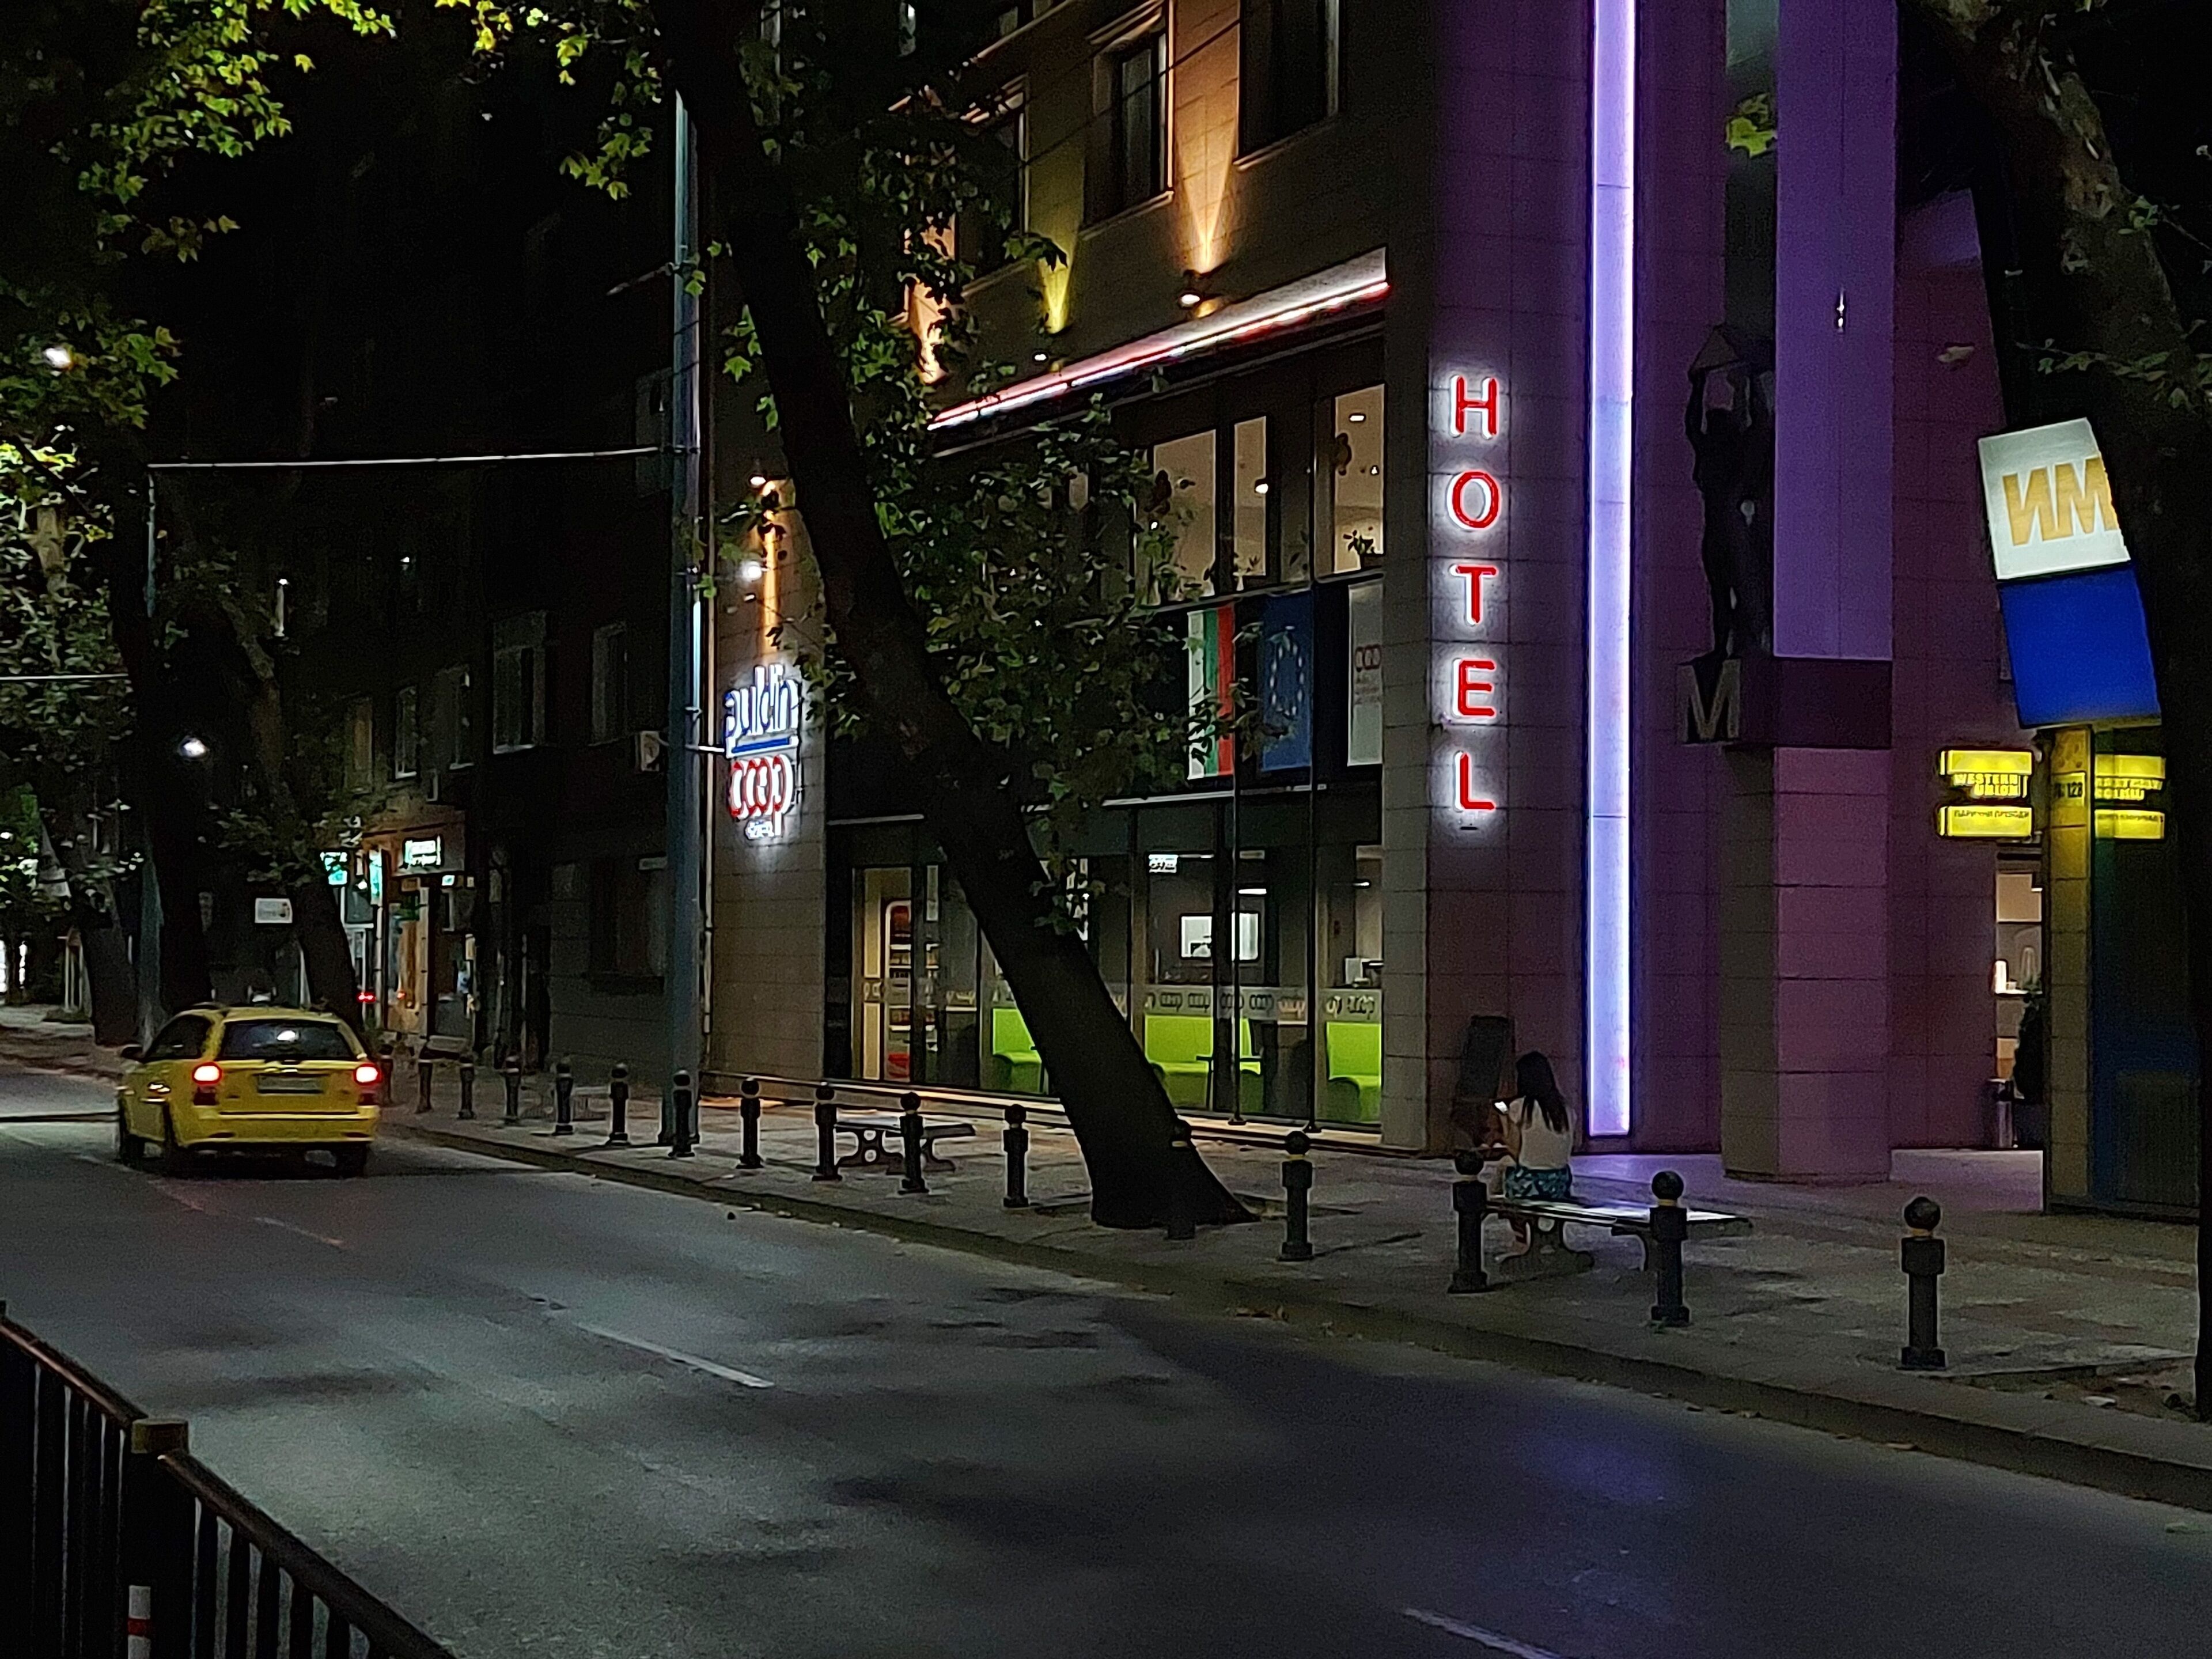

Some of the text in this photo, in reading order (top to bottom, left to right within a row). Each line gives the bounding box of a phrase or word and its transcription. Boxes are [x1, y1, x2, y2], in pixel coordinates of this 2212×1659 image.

[1449, 375, 1499, 810] HOTEL
[1953, 773, 2017, 785] WESTERN
[1974, 784, 2017, 796] UNION
